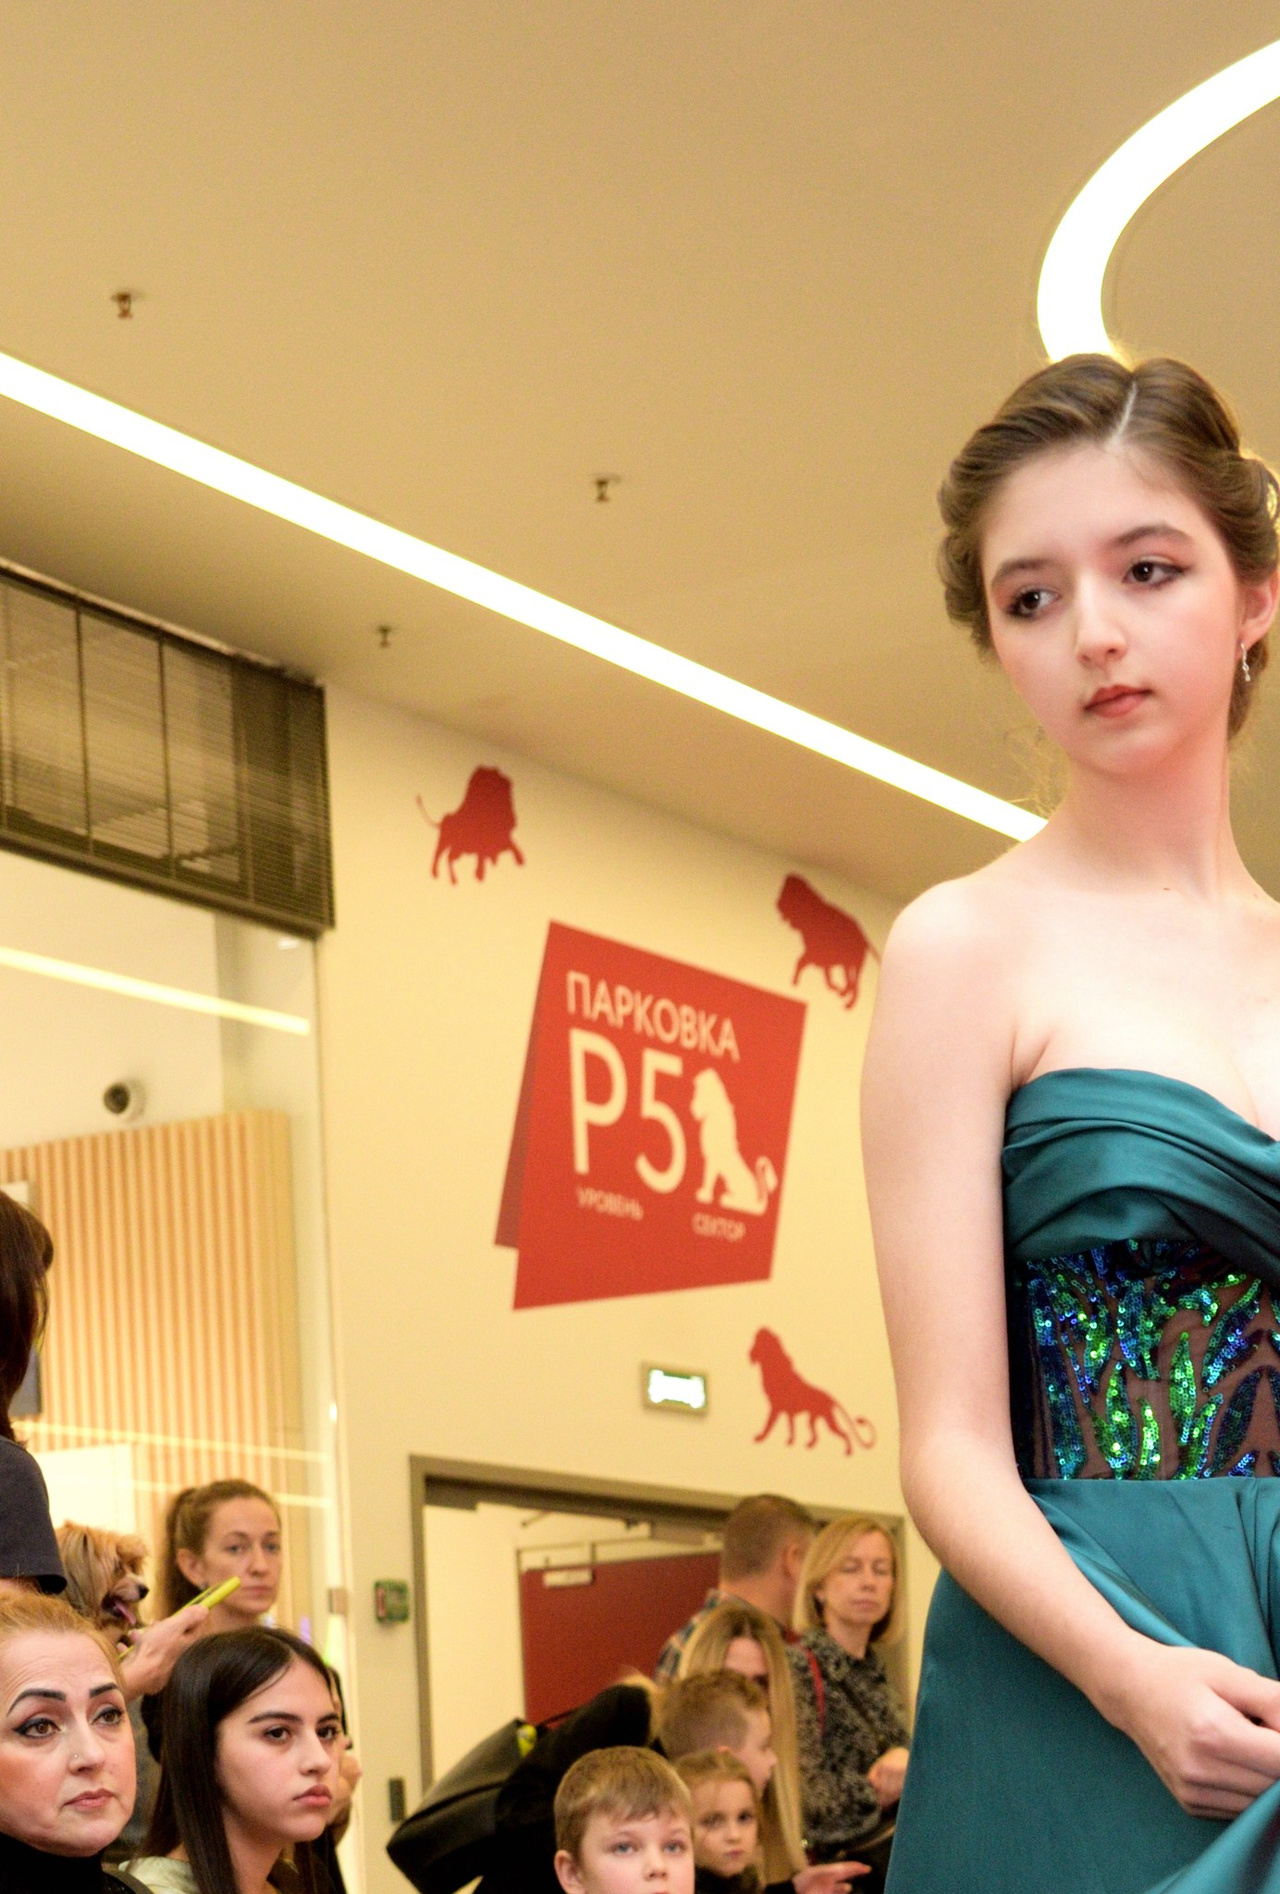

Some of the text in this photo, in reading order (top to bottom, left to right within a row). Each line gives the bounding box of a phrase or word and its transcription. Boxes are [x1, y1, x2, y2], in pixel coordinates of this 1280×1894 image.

[567, 970, 740, 1063] ПАРКОВКА
[569, 1027, 687, 1193] P5
[577, 1186, 644, 1221] УРОВЕНЬ
[692, 1212, 746, 1241] СЕКТОР
